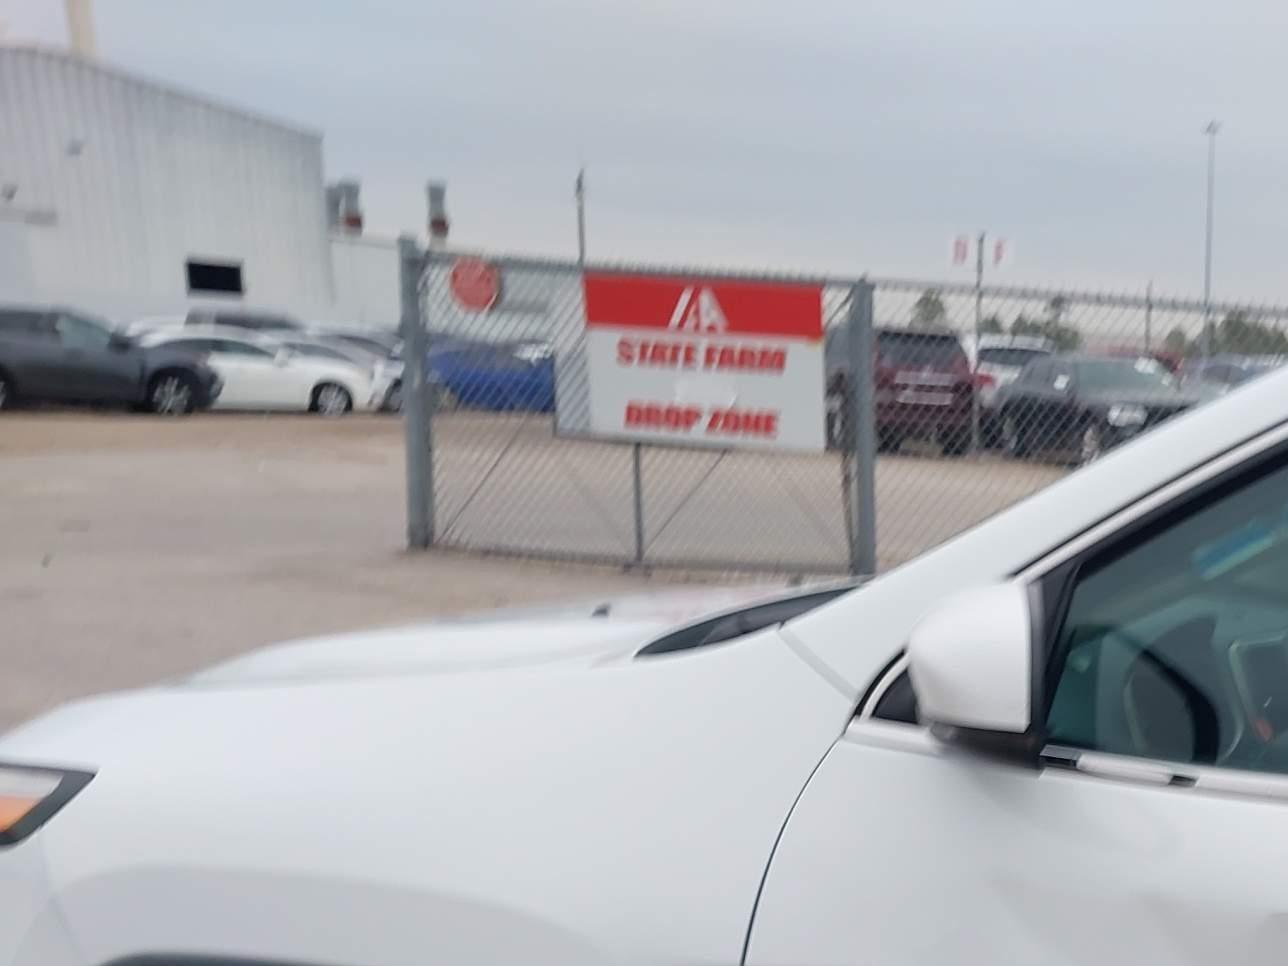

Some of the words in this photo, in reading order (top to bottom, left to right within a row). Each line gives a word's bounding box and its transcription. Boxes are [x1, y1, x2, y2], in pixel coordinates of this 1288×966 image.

[616, 338, 697, 368] STATE
[703, 343, 787, 375] FARM
[624, 400, 703, 432] DROP
[705, 408, 779, 438] ZONE
